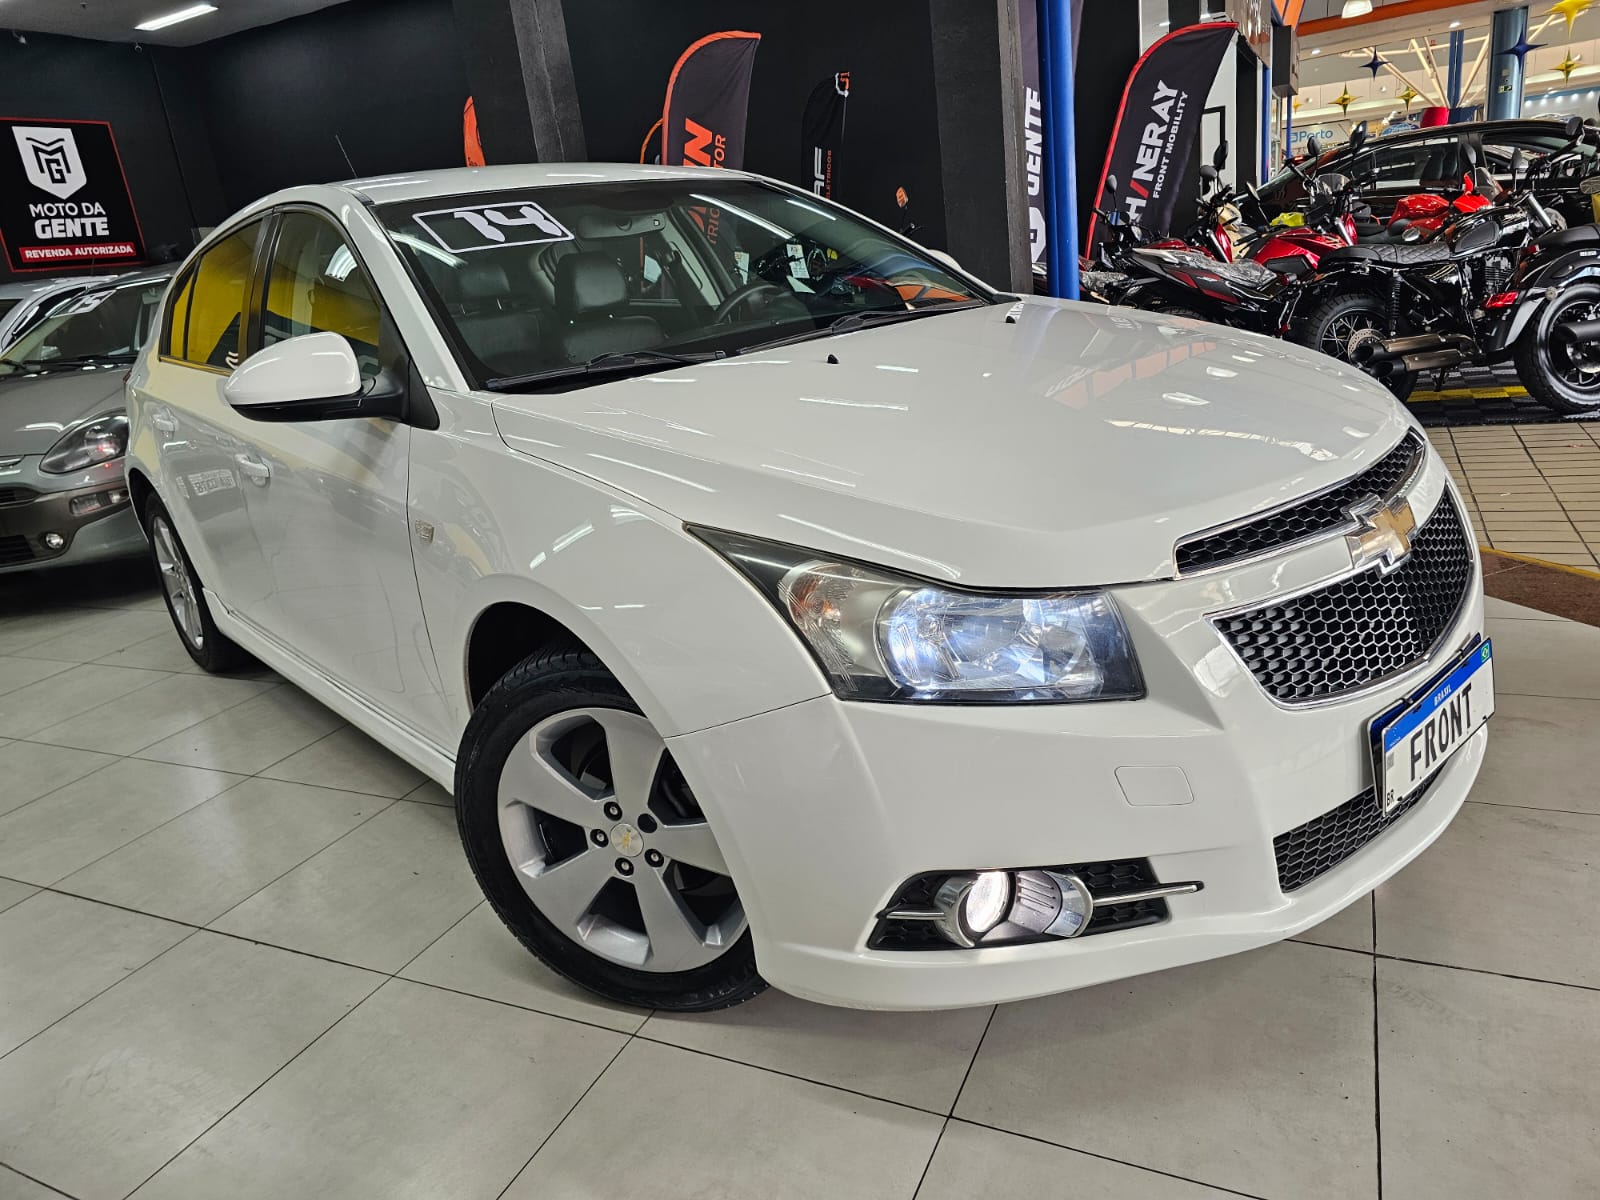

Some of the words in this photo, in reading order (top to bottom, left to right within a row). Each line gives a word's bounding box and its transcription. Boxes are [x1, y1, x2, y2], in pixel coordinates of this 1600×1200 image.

[1124, 79, 1178, 223] HINERAY
[1153, 156, 1170, 199] FRONT
[1165, 91, 1188, 154] MOBILITY
[29, 203, 78, 217] MOTO
[81, 202, 106, 215] DA
[454, 205, 562, 243] 14
[34, 217, 110, 239] GENTE
[25, 247, 74, 258] REVENDA
[75, 245, 133, 255] AUTORIZADA
[1433, 684, 1452, 706] BRASIL
[1410, 682, 1472, 782] FRONT
